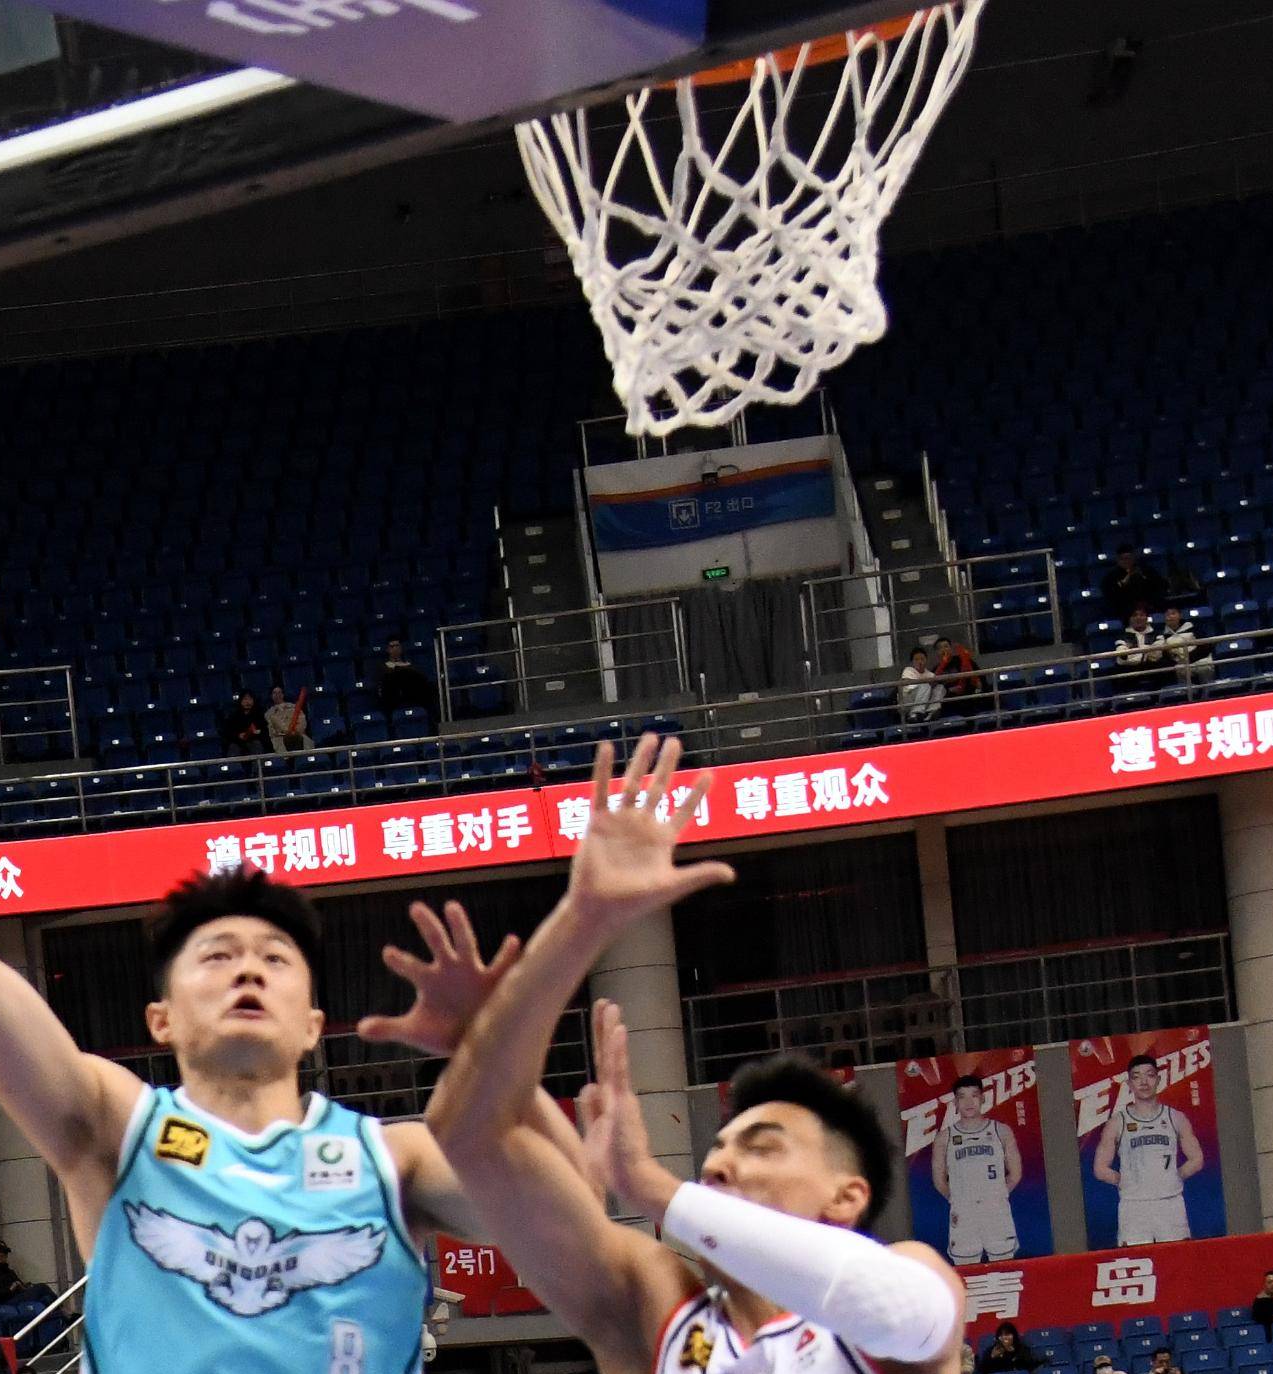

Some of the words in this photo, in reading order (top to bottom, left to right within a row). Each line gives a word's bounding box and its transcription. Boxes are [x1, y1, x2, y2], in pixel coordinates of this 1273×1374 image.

[705, 502, 721, 514] F2
[727, 497, 754, 512] 出口
[381, 803, 533, 860] 尊重对手
[733, 761, 891, 821] 尊重观众
[987, 1164, 998, 1180] 5
[1162, 1155, 1171, 1170] 7
[205, 1250, 299, 1282] QINGDAO
[444, 1247, 496, 1276] 2号门
